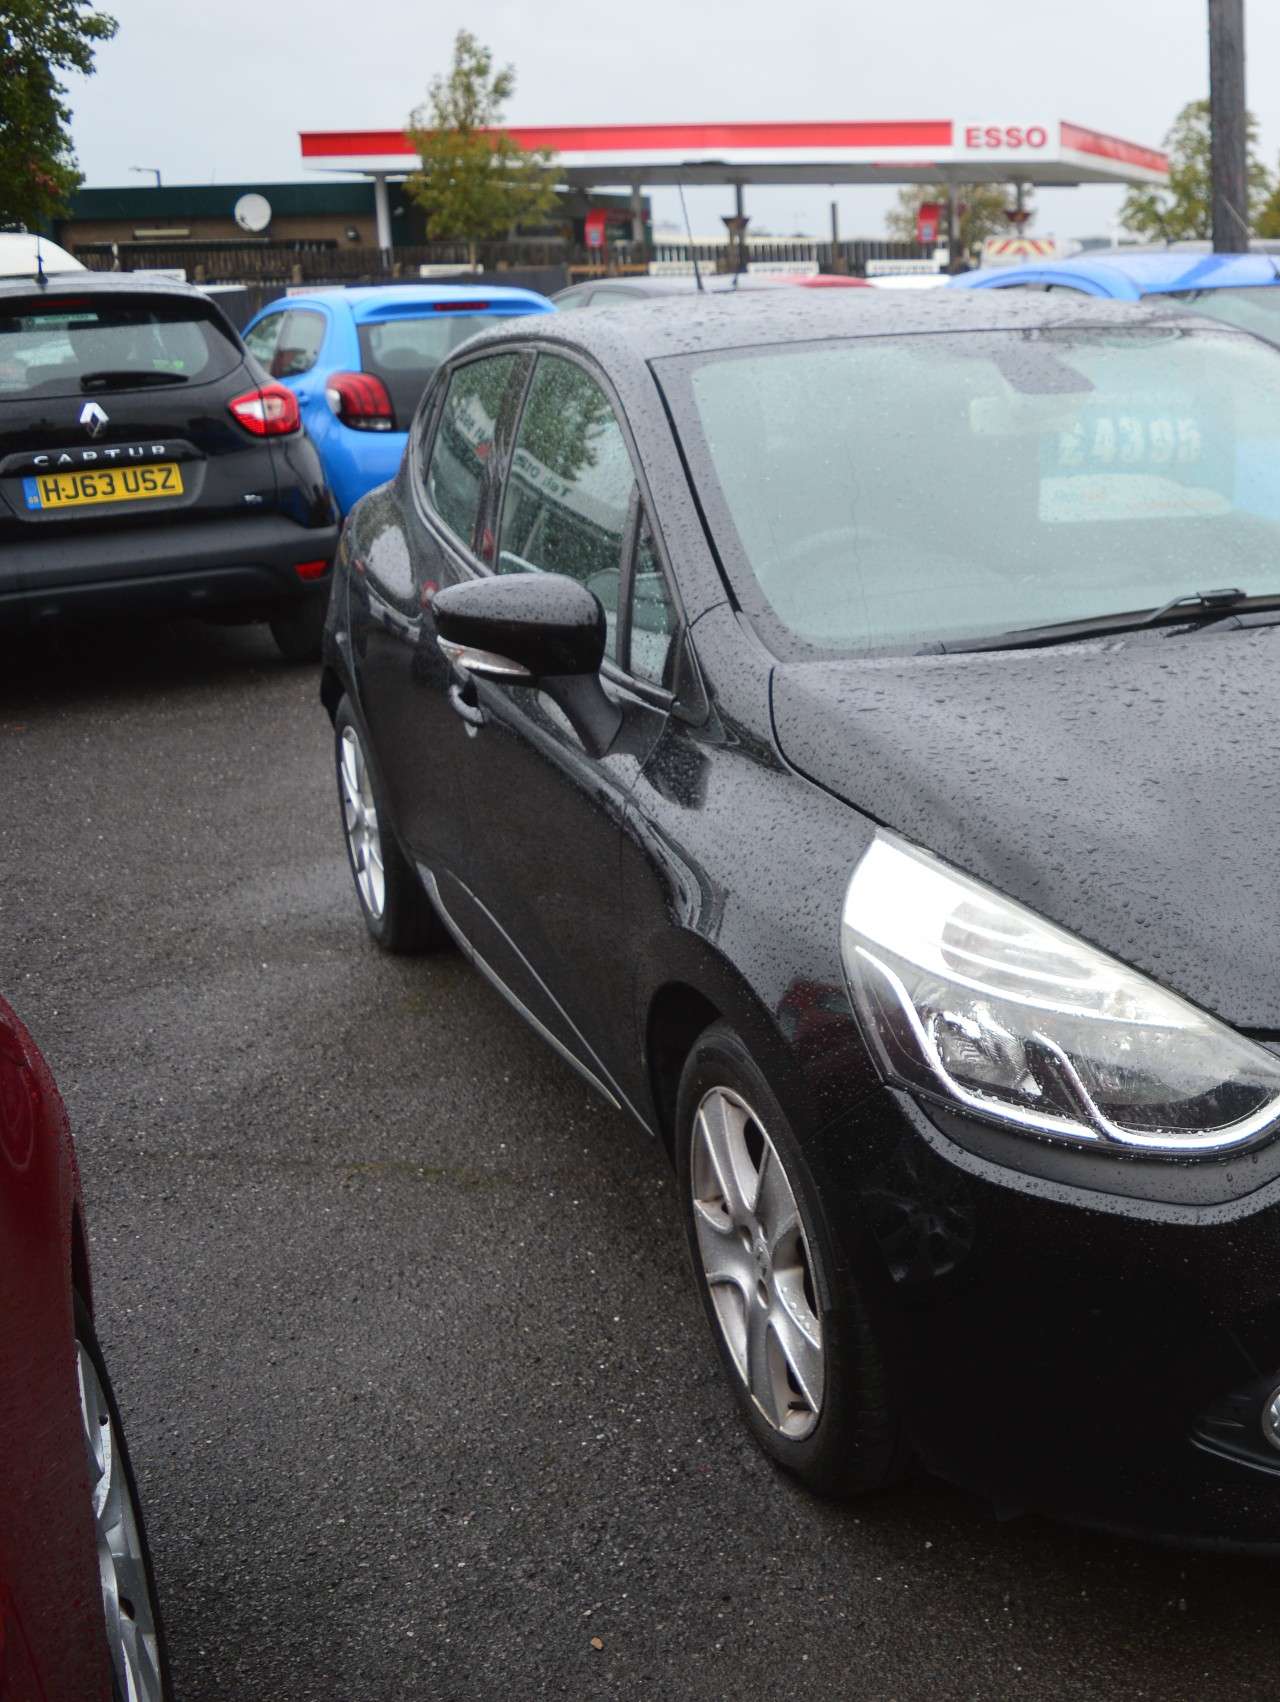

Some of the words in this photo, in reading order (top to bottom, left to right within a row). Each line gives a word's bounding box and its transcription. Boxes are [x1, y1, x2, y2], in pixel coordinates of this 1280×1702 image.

[965, 127, 1048, 149] ESSO
[33, 445, 166, 467] CAPTUR
[43, 473, 116, 503] HJ63
[122, 467, 176, 494] USZ
